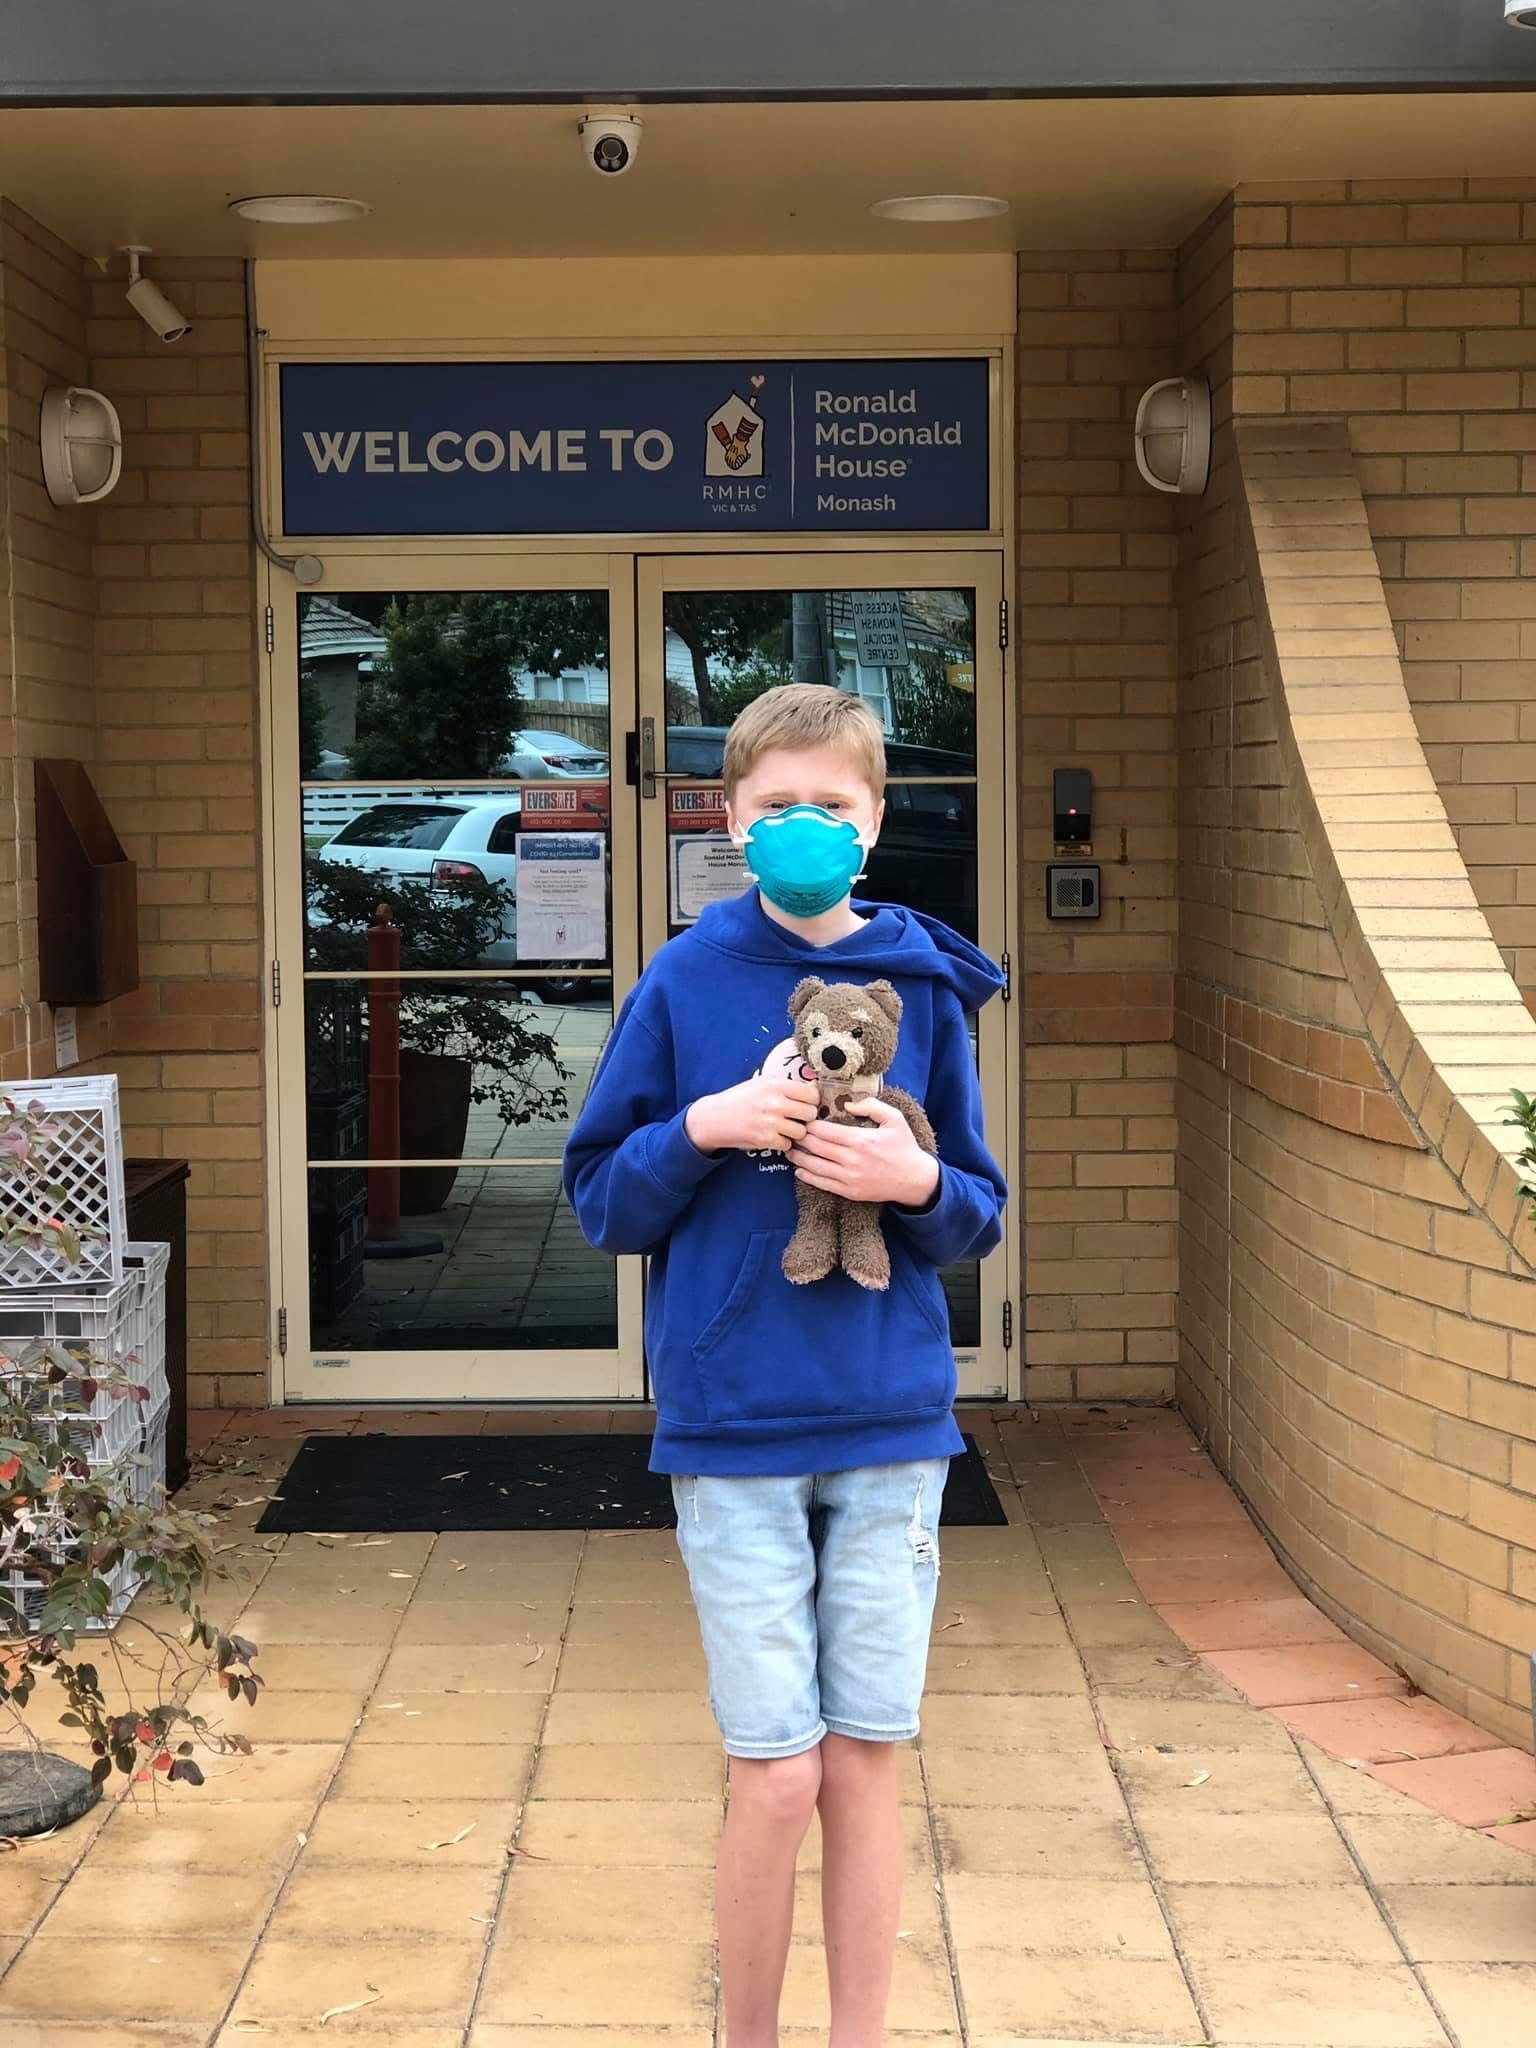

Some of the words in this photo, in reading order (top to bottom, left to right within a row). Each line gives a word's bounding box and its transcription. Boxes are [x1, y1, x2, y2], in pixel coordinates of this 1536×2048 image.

[815, 389, 917, 414] Ronald
[815, 421, 962, 446] McDonald
[302, 430, 587, 473] WELCOME
[599, 429, 674, 471] TO
[703, 484, 767, 500] RMHC
[711, 503, 728, 513] VIC
[730, 504, 737, 513] &
[739, 503, 757, 513] TAS
[817, 494, 896, 512] Monash
[759, 1163, 789, 1173] laughter
